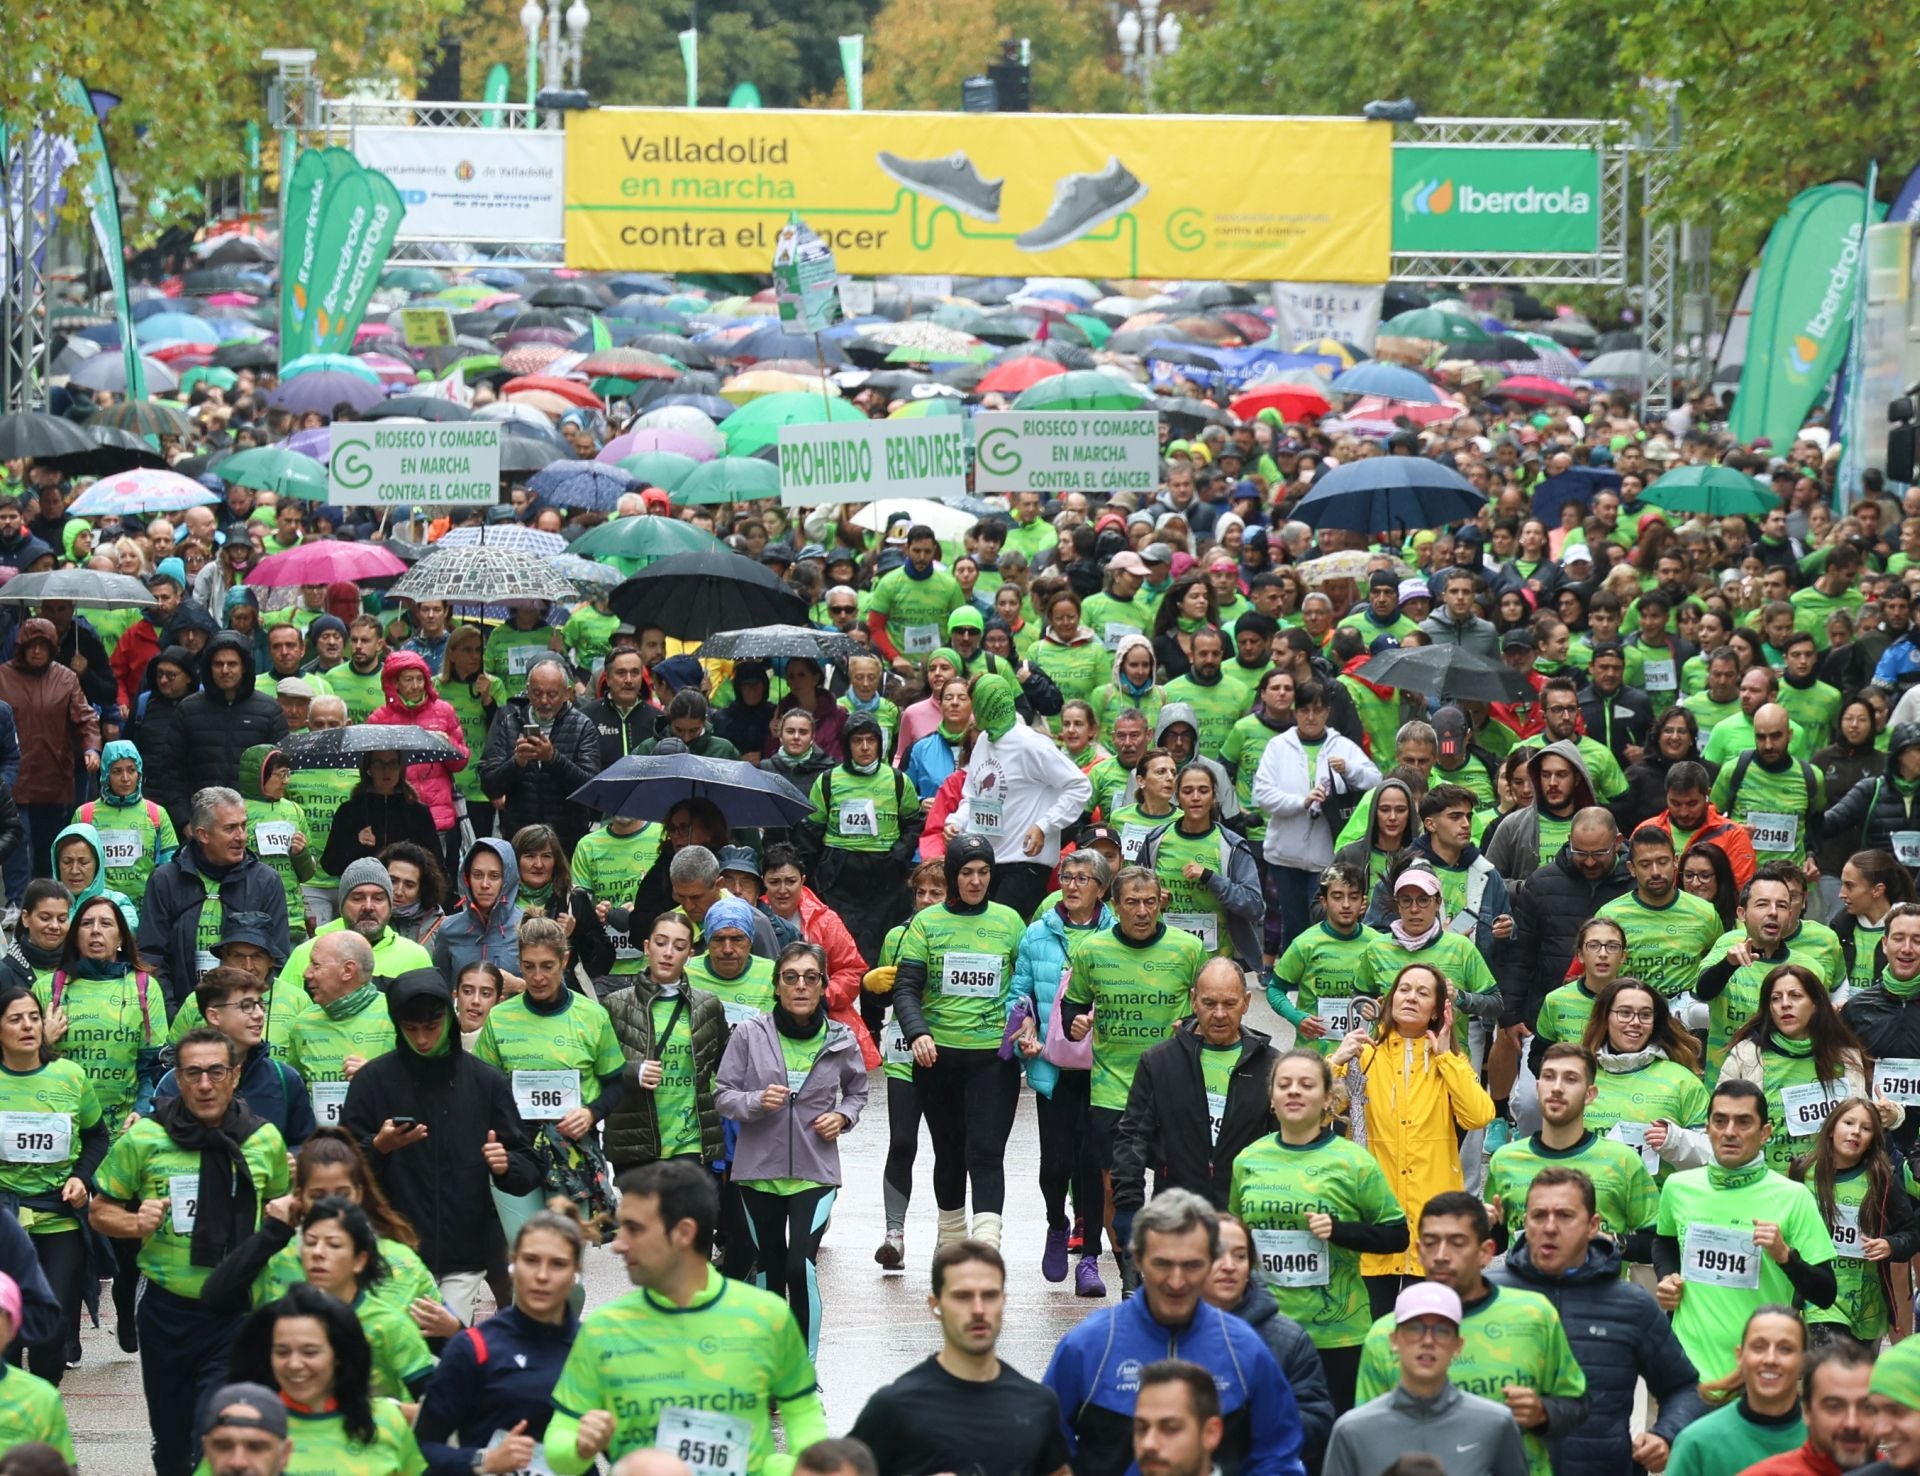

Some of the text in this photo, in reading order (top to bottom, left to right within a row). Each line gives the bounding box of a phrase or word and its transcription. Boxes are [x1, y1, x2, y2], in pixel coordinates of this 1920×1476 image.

[621, 136, 788, 164] Valladolid
[620, 174, 796, 200] en marcha
[1458, 185, 1590, 214] Iberdrola
[620, 222, 726, 247] contra
[736, 223, 766, 248] el
[1023, 420, 1155, 436] RIOSECO Y COMARCA
[375, 430, 497, 448] RIOSECO Y COMARCA
[782, 433, 962, 487] PROHIBIDO RENDIRSE
[1052, 446, 1127, 462] EN MARCHA
[401, 457, 470, 474] EN MARCHA
[1029, 466, 1151, 488] CONTRA EL CÁNCER
[378, 478, 491, 500] CONTRA EL CÁNCER
[307, 794, 350, 806] marc
[975, 812, 999, 827] 37161
[1752, 828, 1789, 843] 29148
[1638, 953, 1697, 968] marcha
[951, 970, 996, 987] 34356
[1314, 977, 1332, 990] En
[1096, 989, 1177, 1006] En marcha
[1096, 1008, 1143, 1022] contra
[1726, 1006, 1746, 1021] En
[74, 1026, 141, 1043] marcha
[1110, 1021, 1167, 1038] cáncer
[531, 1090, 561, 1107] 586
[17, 1132, 54, 1150] 5173
[1261, 1200, 1339, 1217] marcha
[1262, 1253, 1318, 1272] 50406
[1697, 1249, 1746, 1274] 19914
[614, 1386, 758, 1417] En marcha
[678, 1438, 729, 1468] 8516
